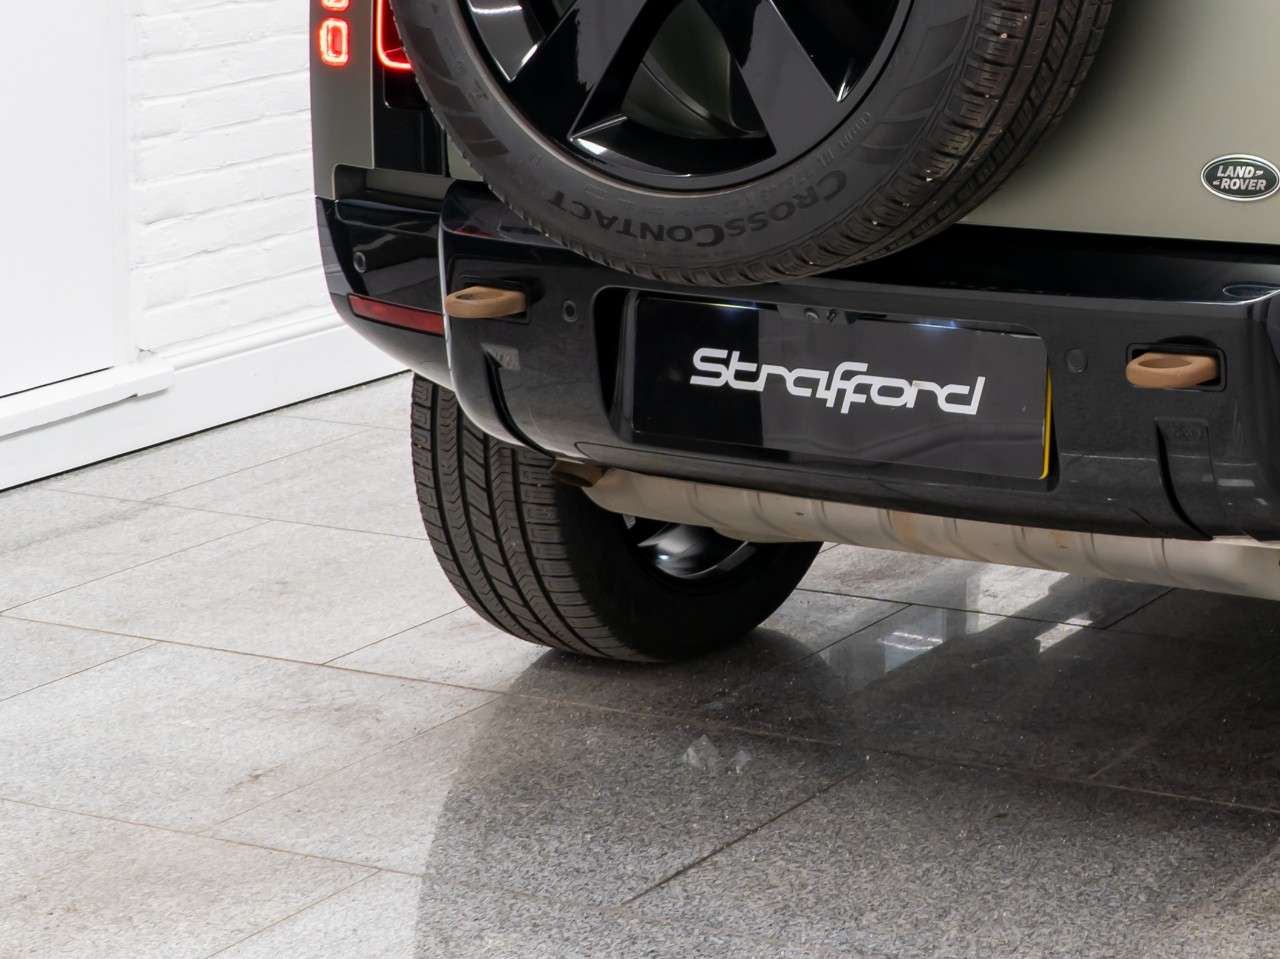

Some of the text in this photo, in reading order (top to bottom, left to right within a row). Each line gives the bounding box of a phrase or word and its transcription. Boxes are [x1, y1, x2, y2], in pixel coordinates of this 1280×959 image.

[1217, 165, 1255, 178] LAND
[1220, 178, 1267, 190] ROVER
[690, 347, 985, 415] Strafford
